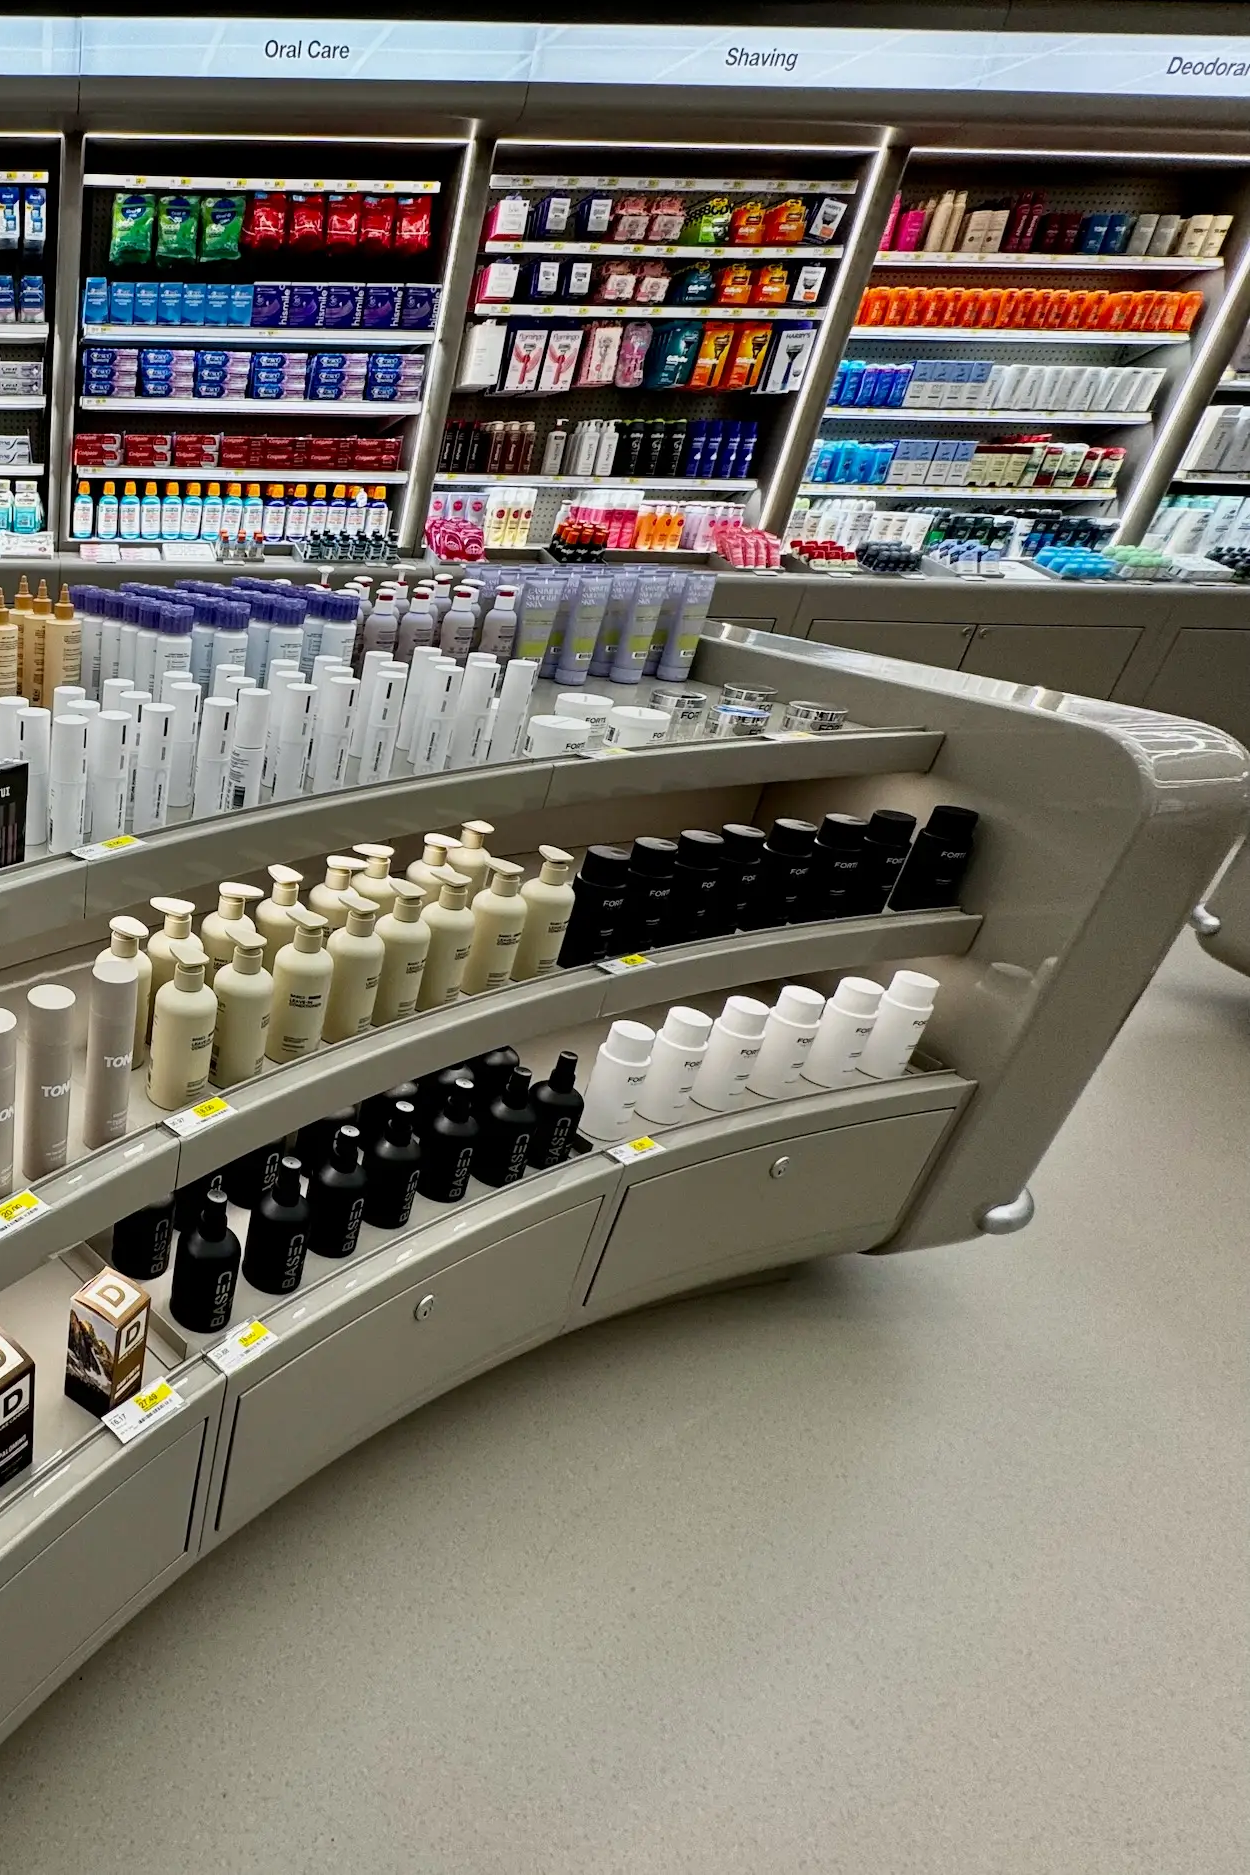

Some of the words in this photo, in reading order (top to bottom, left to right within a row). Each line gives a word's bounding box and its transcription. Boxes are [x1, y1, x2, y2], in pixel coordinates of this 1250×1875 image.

[265, 40, 302, 59] Oral
[307, 41, 350, 59] Care
[725, 47, 799, 72] Shaving
[279, 288, 290, 326] hismile
[315, 289, 328, 326] hismile
[351, 289, 365, 327] hismile
[390, 290, 403, 327] hismile
[552, 333, 580, 343] flamingo
[785, 332, 811, 340] HARRY'S
[649, 888, 670, 898] FORT
[104, 1051, 132, 1068] TON
[40, 1080, 71, 1098] TON
[449, 1147, 473, 1198] BASED
[505, 1133, 530, 1183] BASED
[399, 1169, 421, 1223] BASED
[341, 1197, 365, 1252] BASED
[151, 1218, 169, 1274] BASED
[281, 1233, 305, 1289] BASED
[95, 1283, 126, 1309] D
[210, 1270, 232, 1328] BASED
[124, 1320, 141, 1349] D
[3, 1388, 23, 1419] D
[138, 1393, 158, 1409] 27.49
